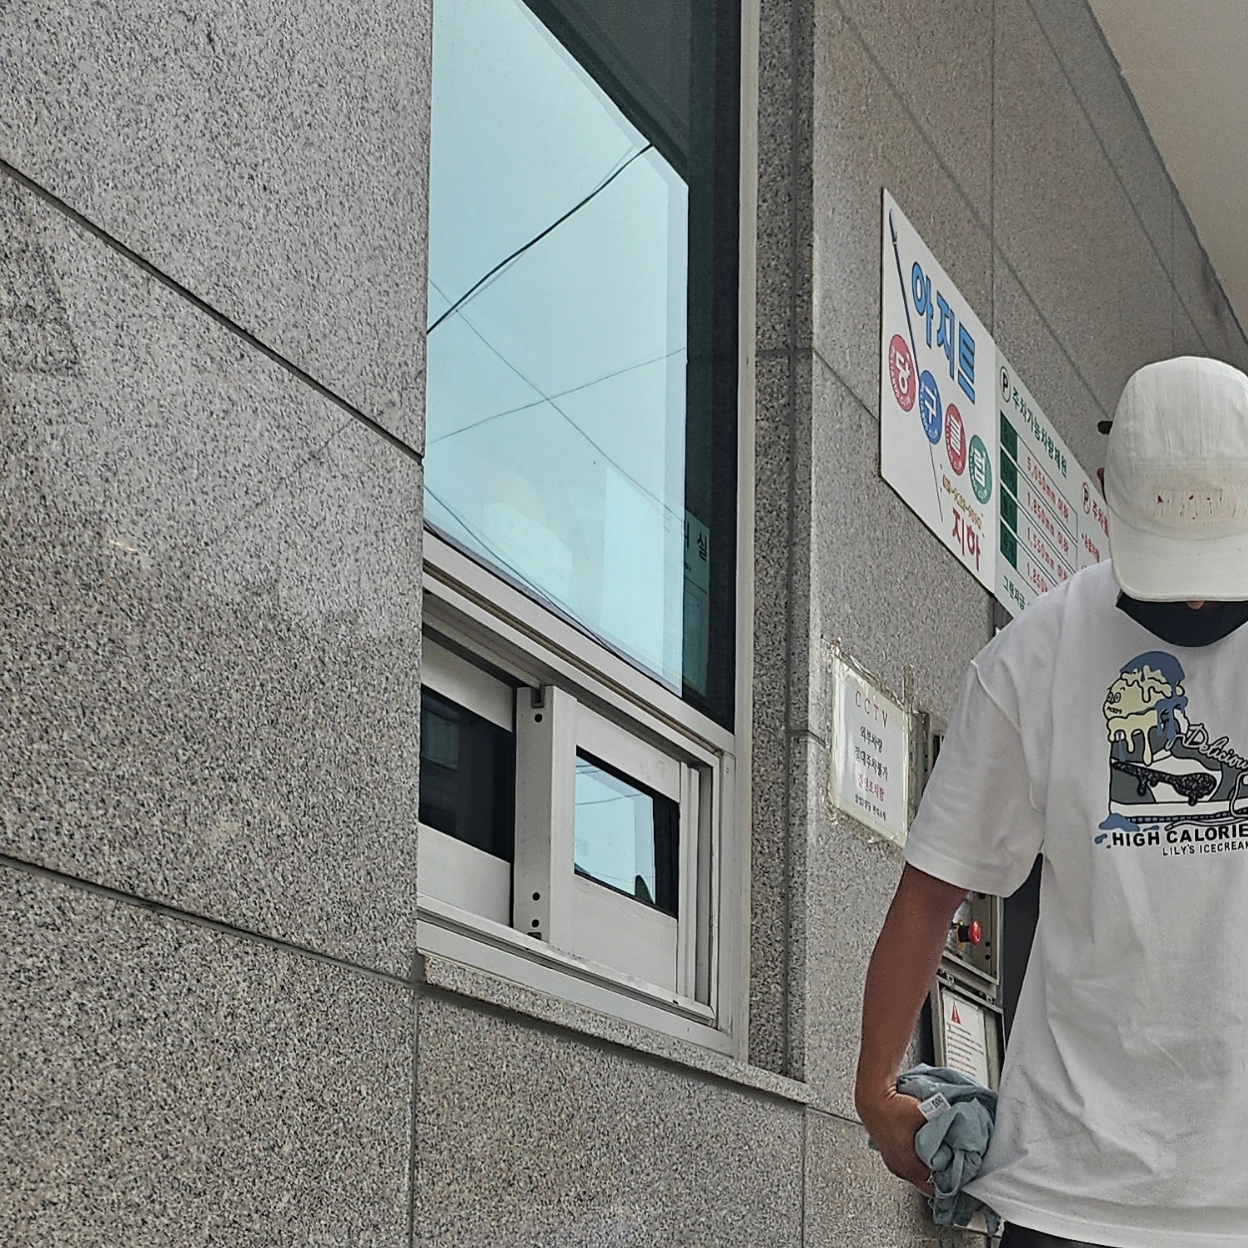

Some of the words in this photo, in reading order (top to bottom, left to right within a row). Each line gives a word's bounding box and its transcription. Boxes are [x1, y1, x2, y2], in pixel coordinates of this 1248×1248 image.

[911, 261, 976, 405] 아지트
[952, 507, 981, 572] 지하
[855, 690, 889, 728] CCTV
[1112, 831, 1160, 847] HIGH
[1162, 843, 1196, 857] LILY'S
